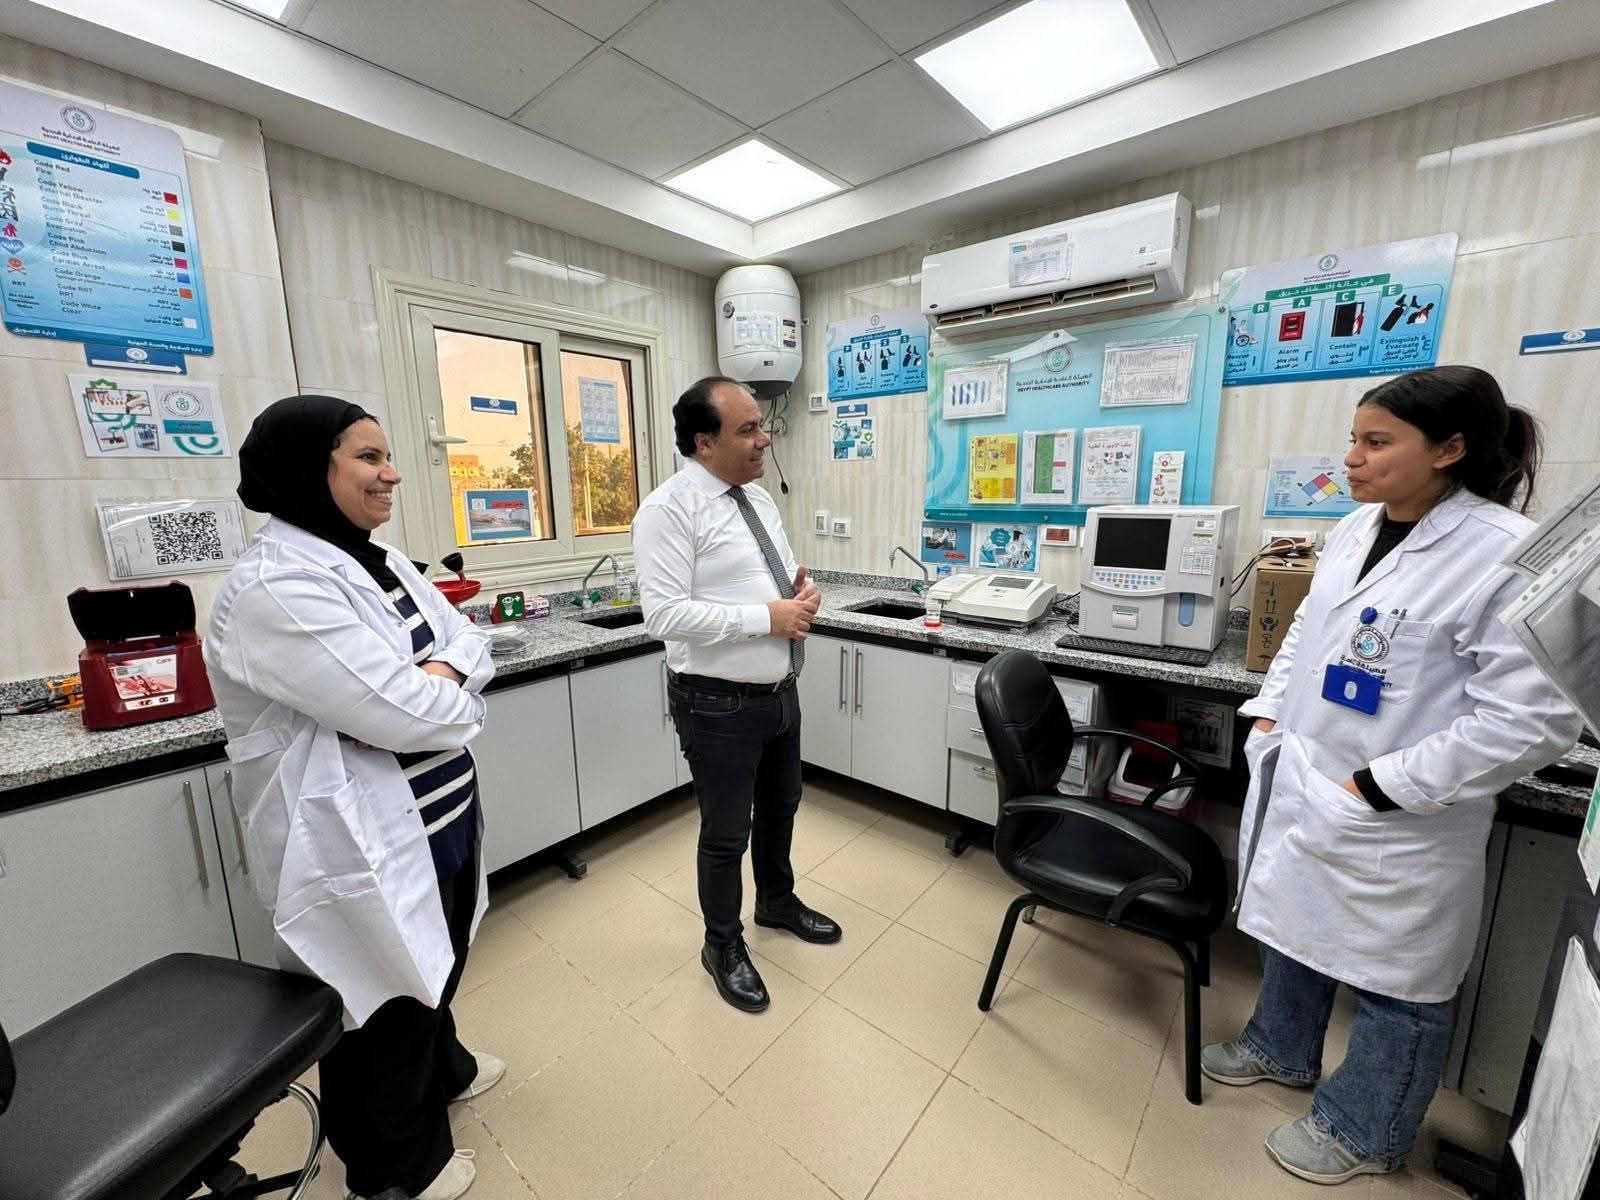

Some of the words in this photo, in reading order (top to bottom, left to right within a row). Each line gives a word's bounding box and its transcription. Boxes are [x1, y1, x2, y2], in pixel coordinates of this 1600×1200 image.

[34, 159, 53, 169] Code
[55, 164, 71, 173] Red
[36, 166, 52, 175] Fire
[37, 177, 57, 188] Code
[58, 181, 84, 193] Yellow
[41, 196, 61, 206] Code
[62, 200, 84, 210] Black
[44, 214, 64, 223] Code
[46, 221, 88, 235] Evacuation
[48, 232, 67, 242] Code
[68, 236, 86, 245] Pink
[49, 239, 69, 249] Child
[70, 244, 108, 256] Abduction
[51, 248, 70, 257] Code
[55, 267, 74, 276] Code
[75, 271, 102, 281] Orange
[1336, 281, 1359, 289] حالة
[1360, 278, 1375, 287] في
[58, 283, 77, 292] Code
[77, 286, 93, 294] RRT
[59, 290, 74, 299] RRT
[1257, 304, 1265, 313] R
[1297, 298, 1306, 307] A
[1341, 292, 1350, 301] C
[1388, 285, 1397, 295] E
[60, 299, 80, 308] Code
[81, 302, 102, 311] White
[62, 306, 82, 315] Clear
[1380, 336, 1420, 345] Extinguish
[1329, 342, 1357, 351] Contain
[1385, 342, 1420, 350] Evacuate
[1032, 383, 1062, 391] HEALTHCARE
